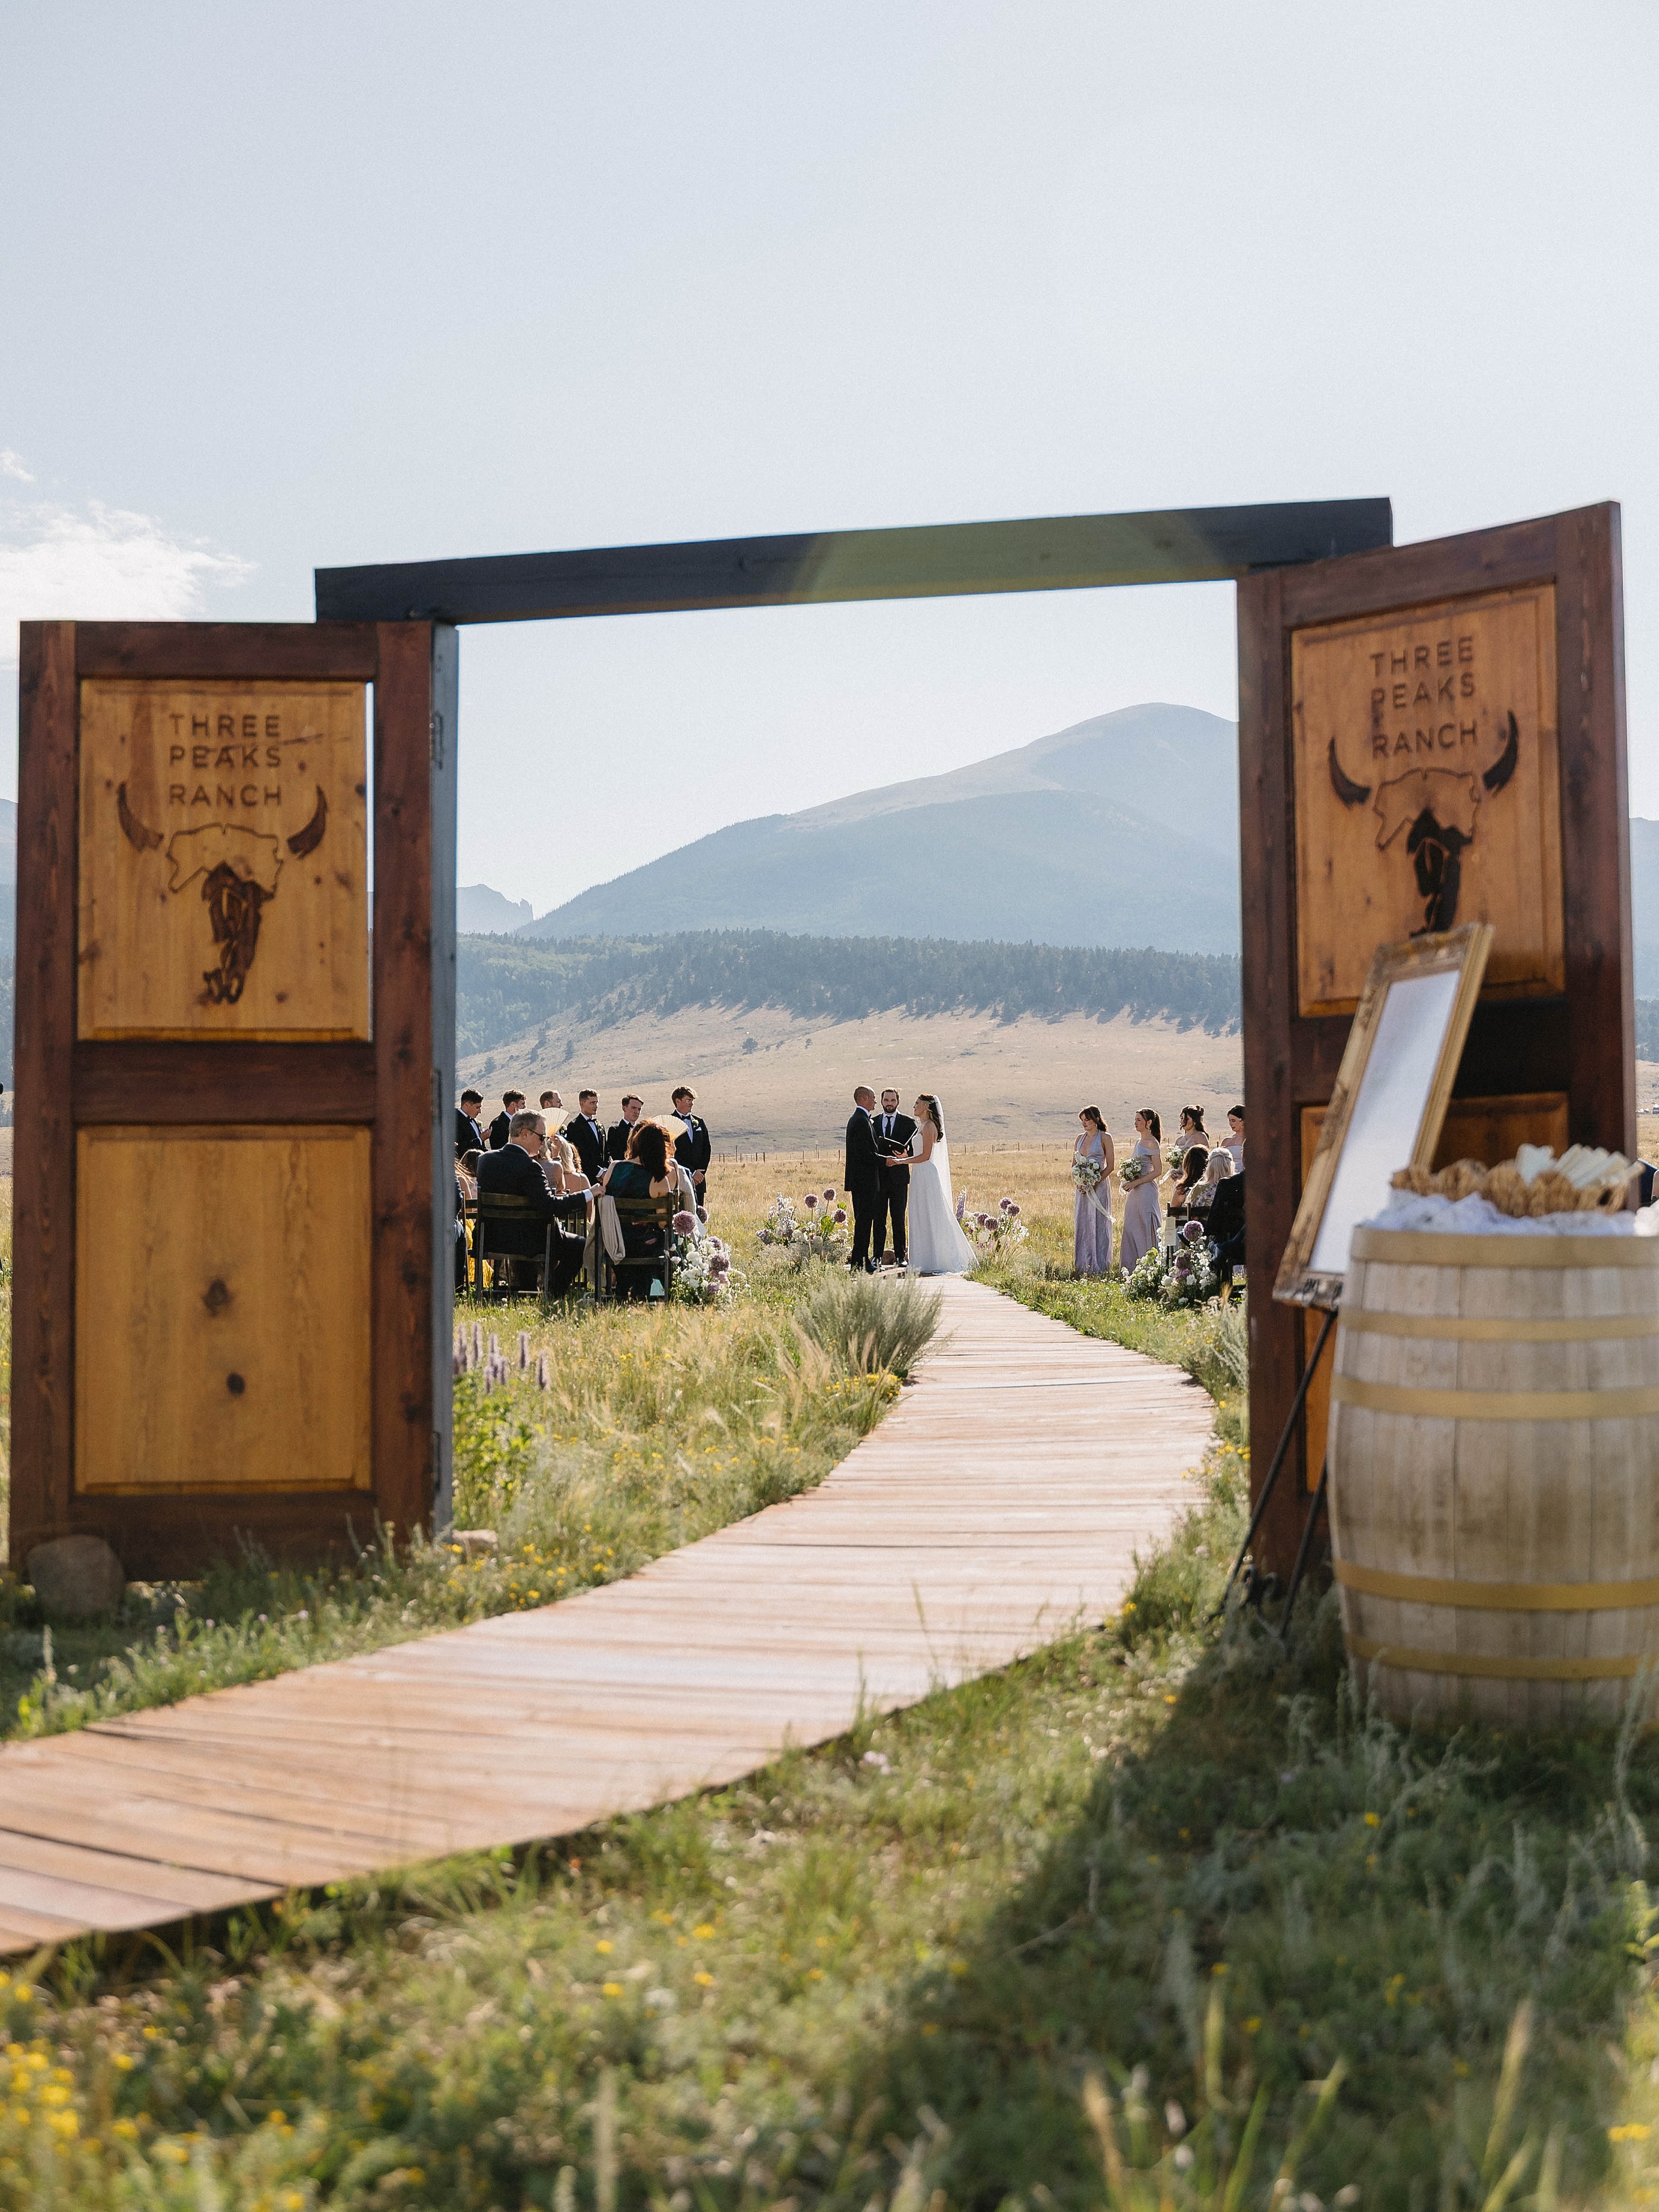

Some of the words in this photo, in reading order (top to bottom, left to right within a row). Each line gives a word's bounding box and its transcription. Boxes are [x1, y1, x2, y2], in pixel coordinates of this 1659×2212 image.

[1370, 636, 1473, 677] THREE
[1371, 672, 1475, 711] PEAKS
[169, 714, 280, 737] THREE
[1372, 719, 1477, 759] RANCH
[170, 745, 280, 768] PEAKS
[169, 784, 281, 807] RANCH
